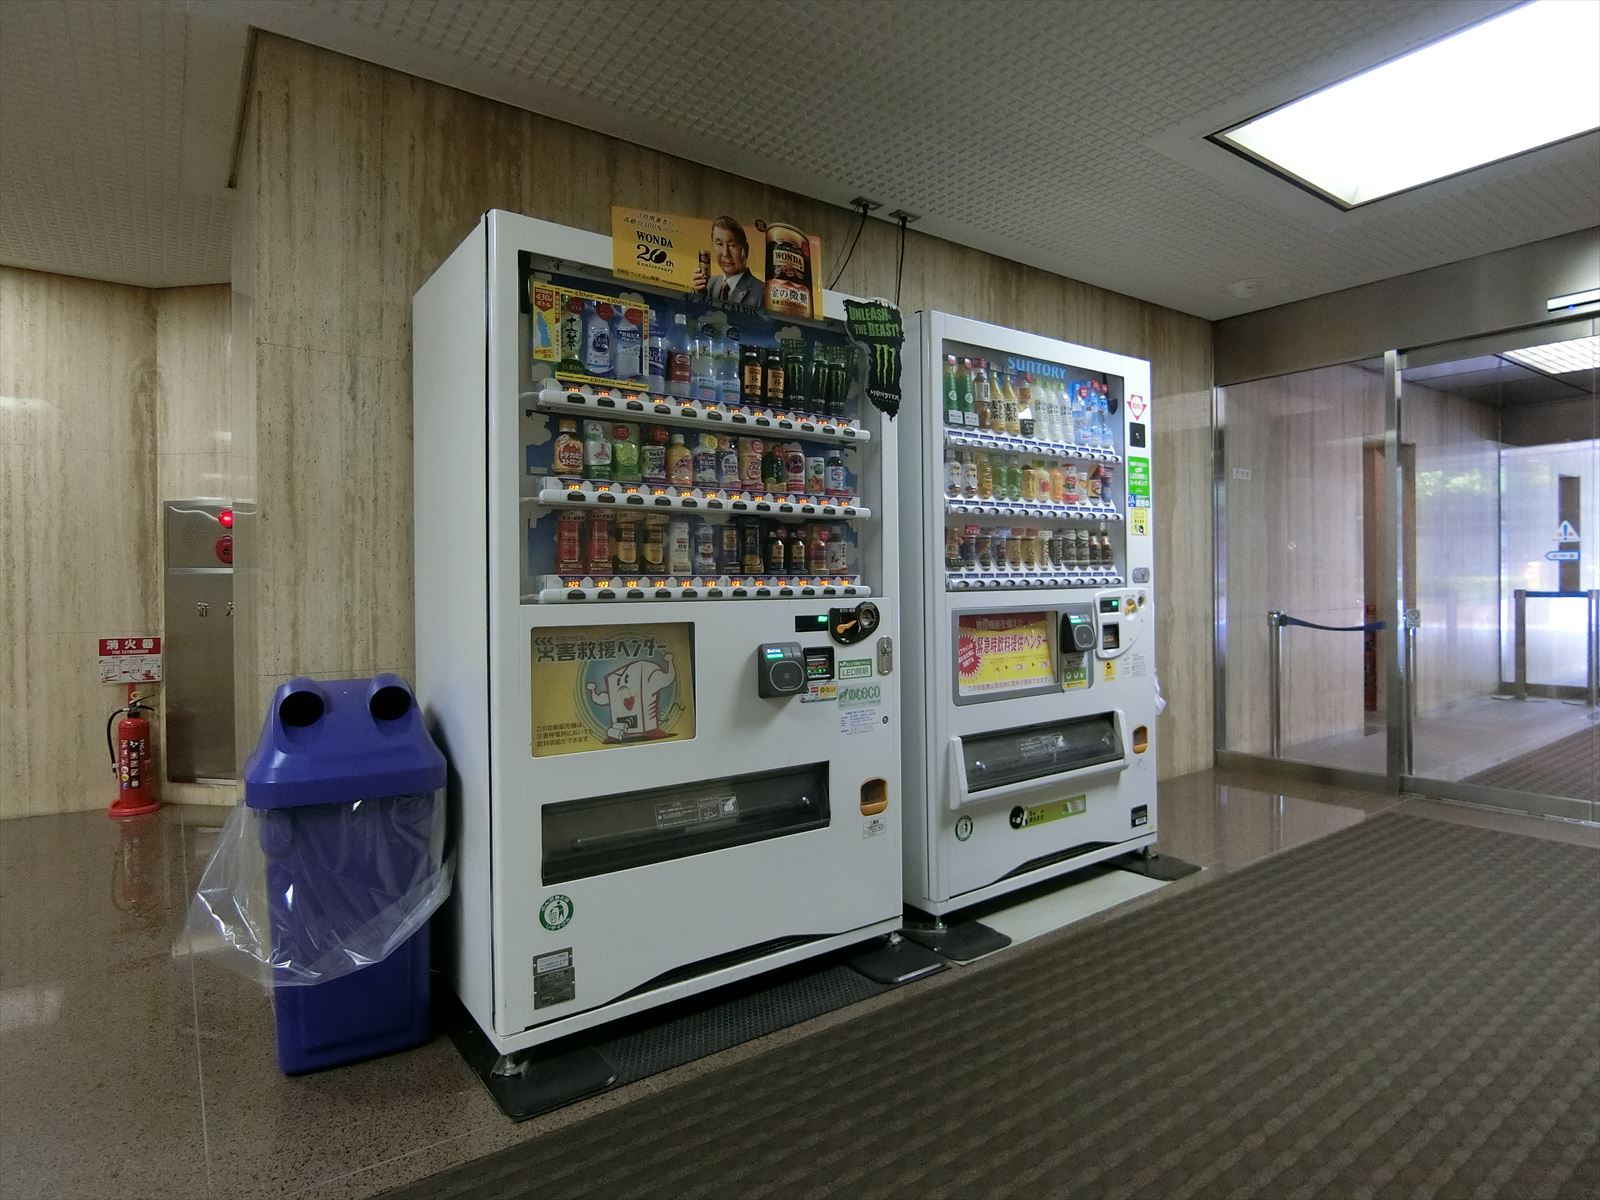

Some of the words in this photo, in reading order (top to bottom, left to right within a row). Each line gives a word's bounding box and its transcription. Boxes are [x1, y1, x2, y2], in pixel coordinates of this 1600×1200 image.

[636, 231, 673, 249] WONDA
[775, 252, 803, 267] WONDA
[636, 261, 674, 275] Anniversary
[771, 286, 808, 304] 金の微糖
[848, 306, 888, 321] UNLEASH
[566, 316, 579, 351] 十六茶
[854, 323, 868, 335] THE
[867, 322, 900, 337] BEAST!
[1007, 356, 1066, 380] SUNTORY
[870, 389, 900, 402] MONSTER
[106, 638, 154, 651] 消火器
[534, 636, 668, 663] 災害救援ベンダー
